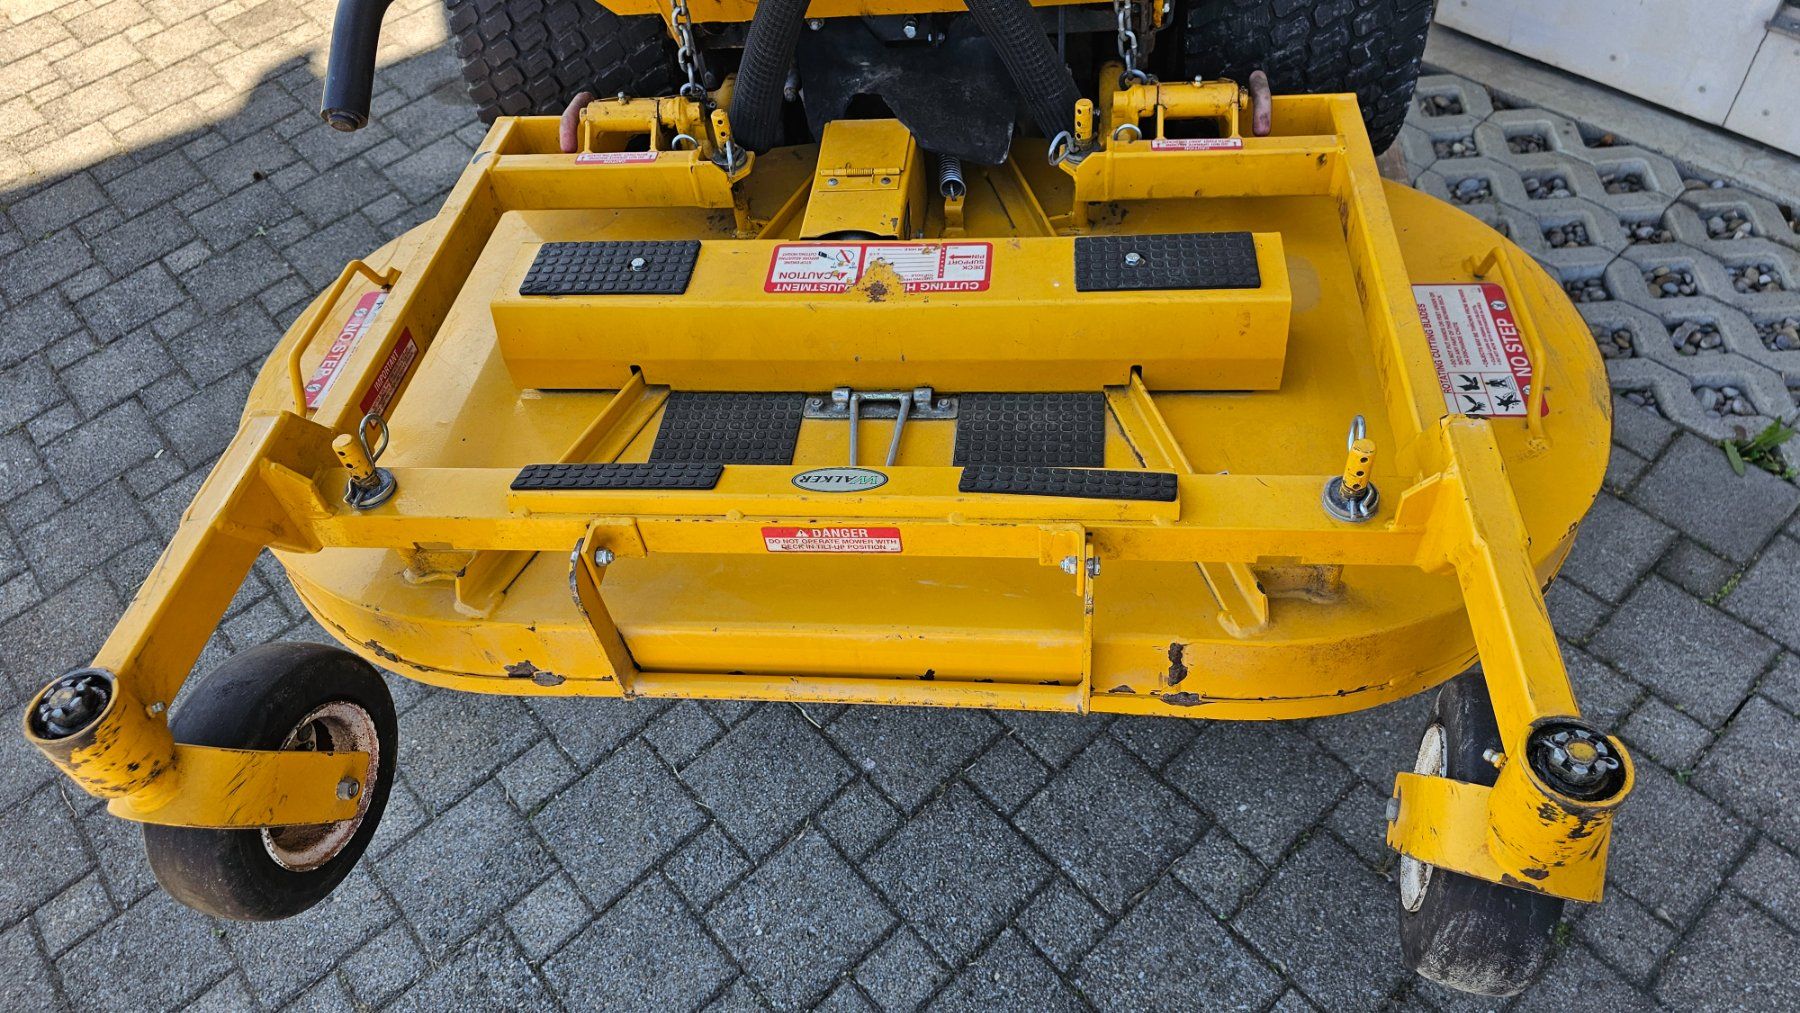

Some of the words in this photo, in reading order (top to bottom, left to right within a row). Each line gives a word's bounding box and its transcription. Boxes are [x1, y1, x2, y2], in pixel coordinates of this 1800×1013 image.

[779, 272, 832, 280] CAUTION
[920, 282, 979, 291] CUTTING
[774, 284, 849, 292] JUSTMENT
[1418, 304, 1431, 328] BLADES
[339, 322, 359, 341] NO
[1497, 318, 1523, 352] STEP
[1425, 329, 1441, 358] CUTTING
[319, 342, 346, 377] STEP
[1510, 356, 1532, 377] NO
[374, 349, 398, 392] IMPORTANT
[1434, 360, 1452, 393] ROTATING
[799, 475, 878, 485] WALKER
[812, 528, 868, 537] DANGER
